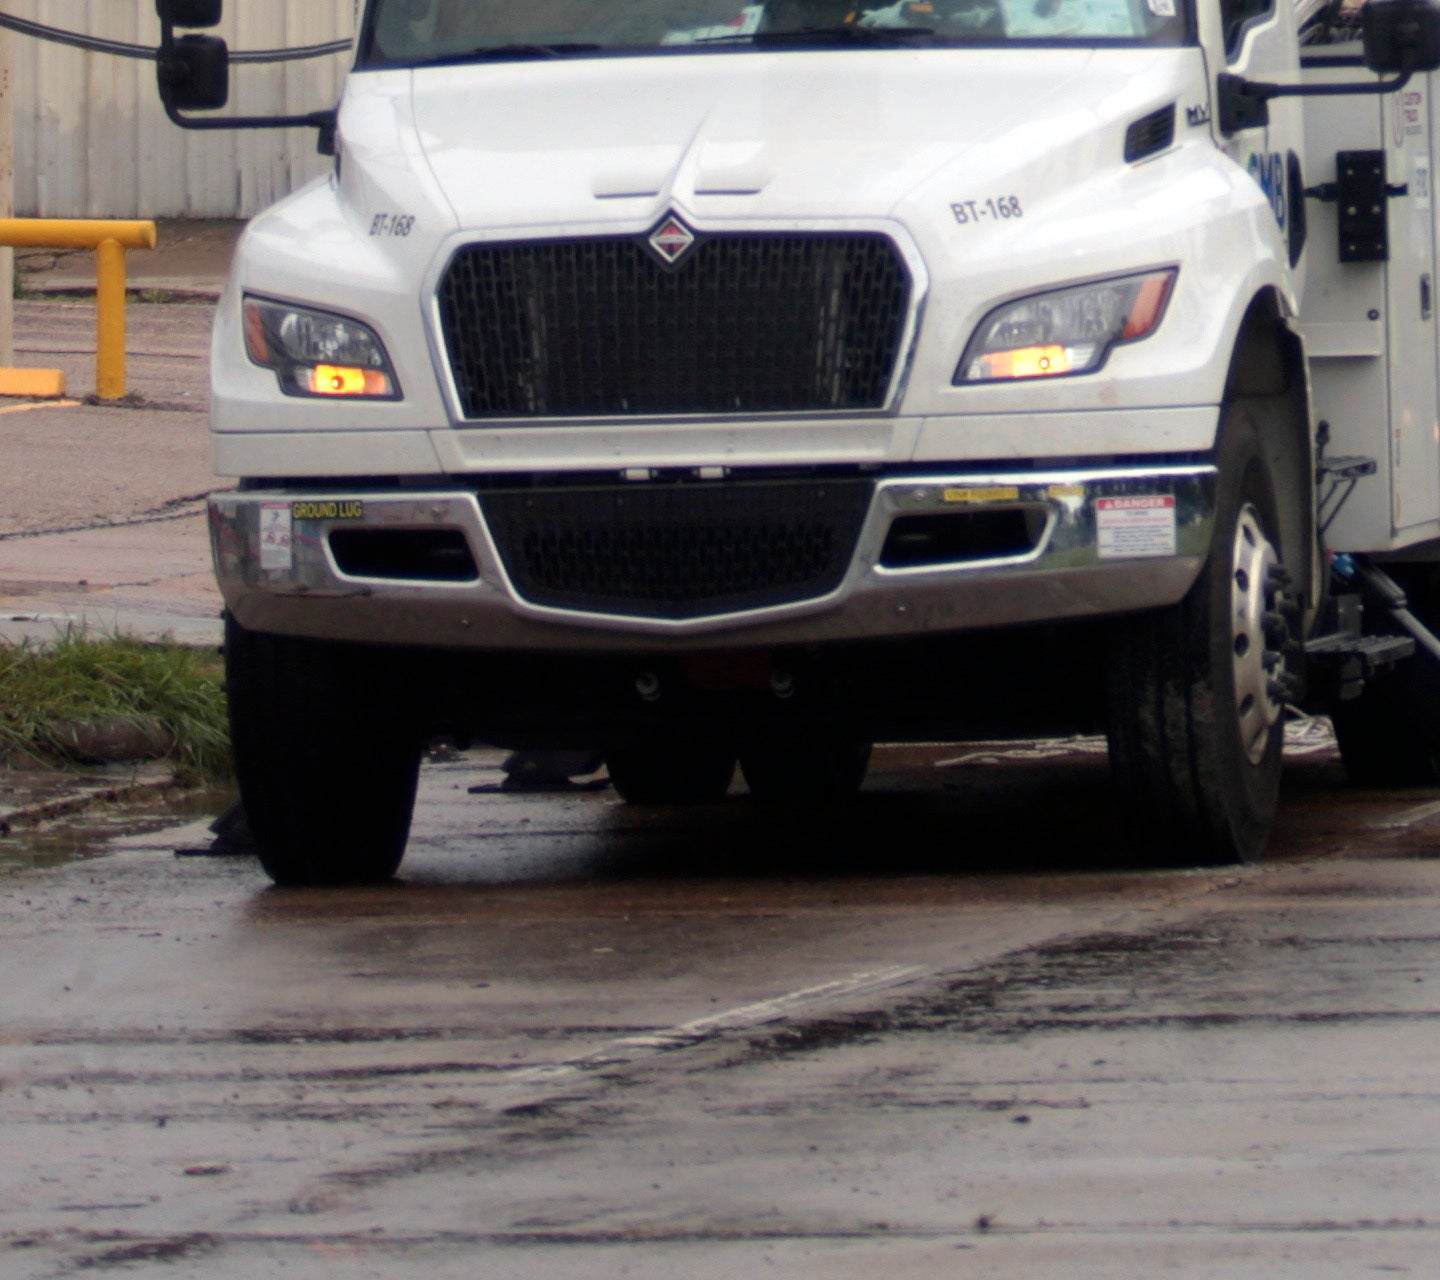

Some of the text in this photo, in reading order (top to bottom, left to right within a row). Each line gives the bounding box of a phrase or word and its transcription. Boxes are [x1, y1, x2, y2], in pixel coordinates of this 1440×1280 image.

[950, 196, 1023, 225] BT-168
[368, 213, 416, 236] BT-168
[293, 501, 362, 519] GROUND LUG
